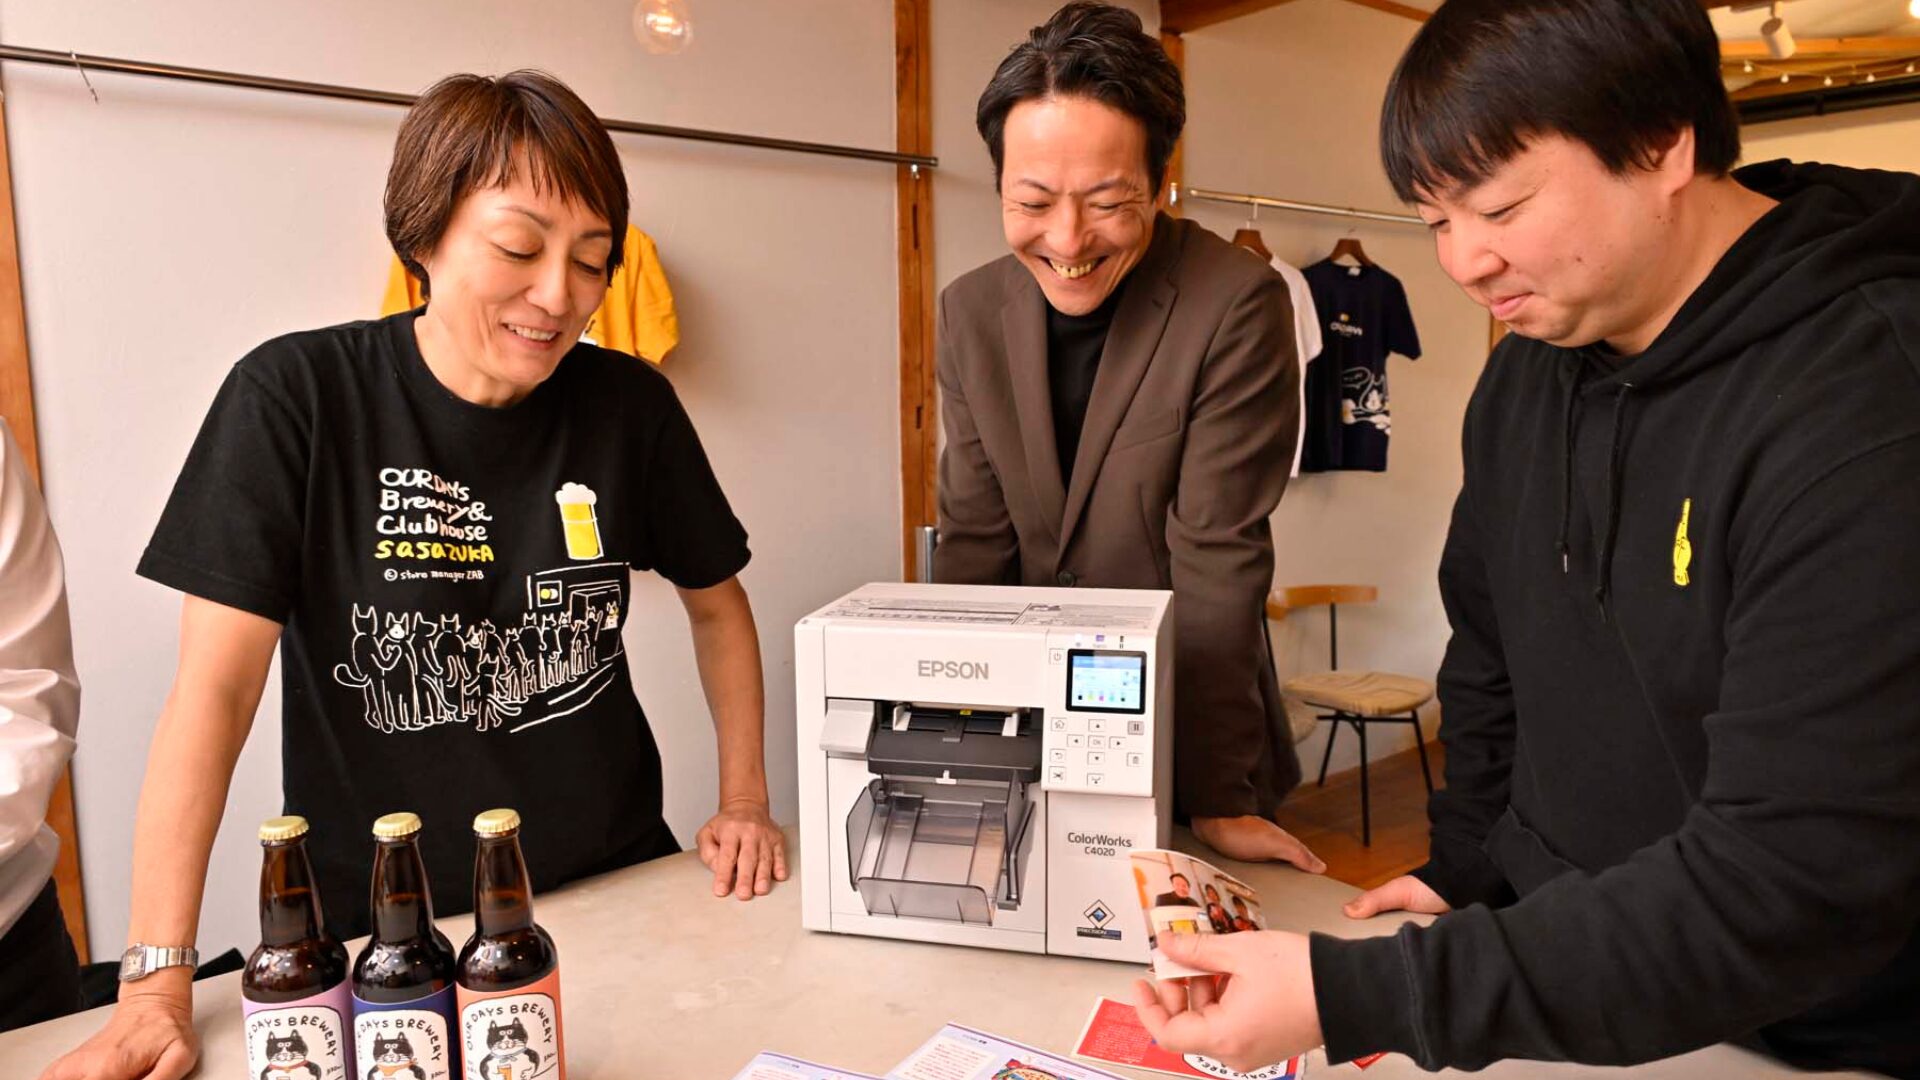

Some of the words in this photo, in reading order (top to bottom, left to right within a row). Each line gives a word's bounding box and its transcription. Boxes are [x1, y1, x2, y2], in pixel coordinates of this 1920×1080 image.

[379, 467, 434, 488] OUR
[918, 659, 989, 680] EPSON
[1067, 832, 1132, 848] ColorWorks
[1084, 846, 1115, 857] C4020
[471, 1007, 503, 1022] DAYS
[510, 1003, 552, 1043] BREWERY
[252, 1019, 281, 1032] DAYS
[288, 1015, 337, 1056] BREWERY
[360, 1020, 389, 1033] DAYS
[396, 1018, 442, 1061] BREWERY
